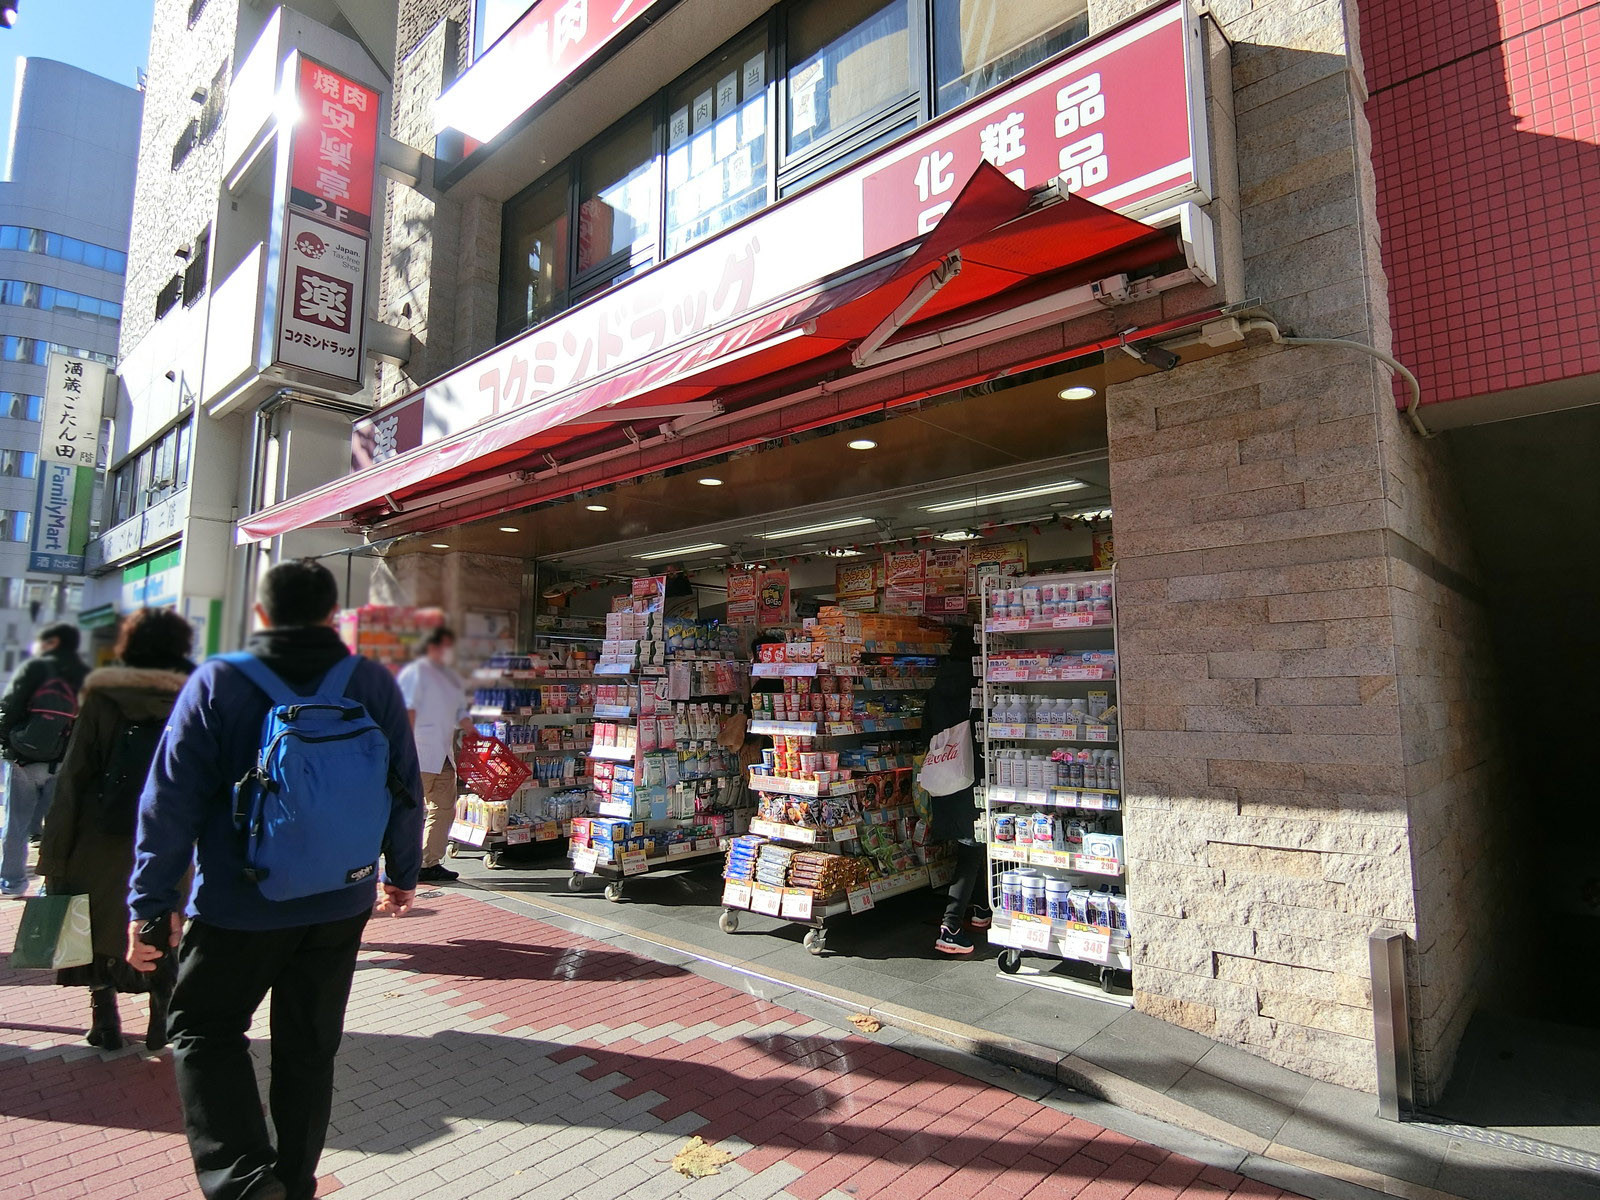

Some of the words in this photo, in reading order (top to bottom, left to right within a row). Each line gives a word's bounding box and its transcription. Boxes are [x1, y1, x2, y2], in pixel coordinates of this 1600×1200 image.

[312, 69, 369, 113] 焼肉
[913, 72, 1106, 202] 化粧品
[313, 197, 350, 223] 2F
[332, 251, 361, 267] Tax-free
[342, 260, 361, 273] Shop
[299, 275, 347, 327] 薬
[478, 235, 762, 423] コクミンドラッグ
[284, 328, 357, 359] コクミンドラッグ
[55, 360, 84, 459] 酒蔵ごたん田
[372, 414, 400, 464] 薬
[45, 465, 71, 551] FamilyMart
[36, 556, 50, 568] 酒
[53, 557, 79, 570] たばこ
[765, 598, 782, 607] GoGo
[1100, 862, 1115, 871] 298
[1083, 940, 1103, 955] 348
